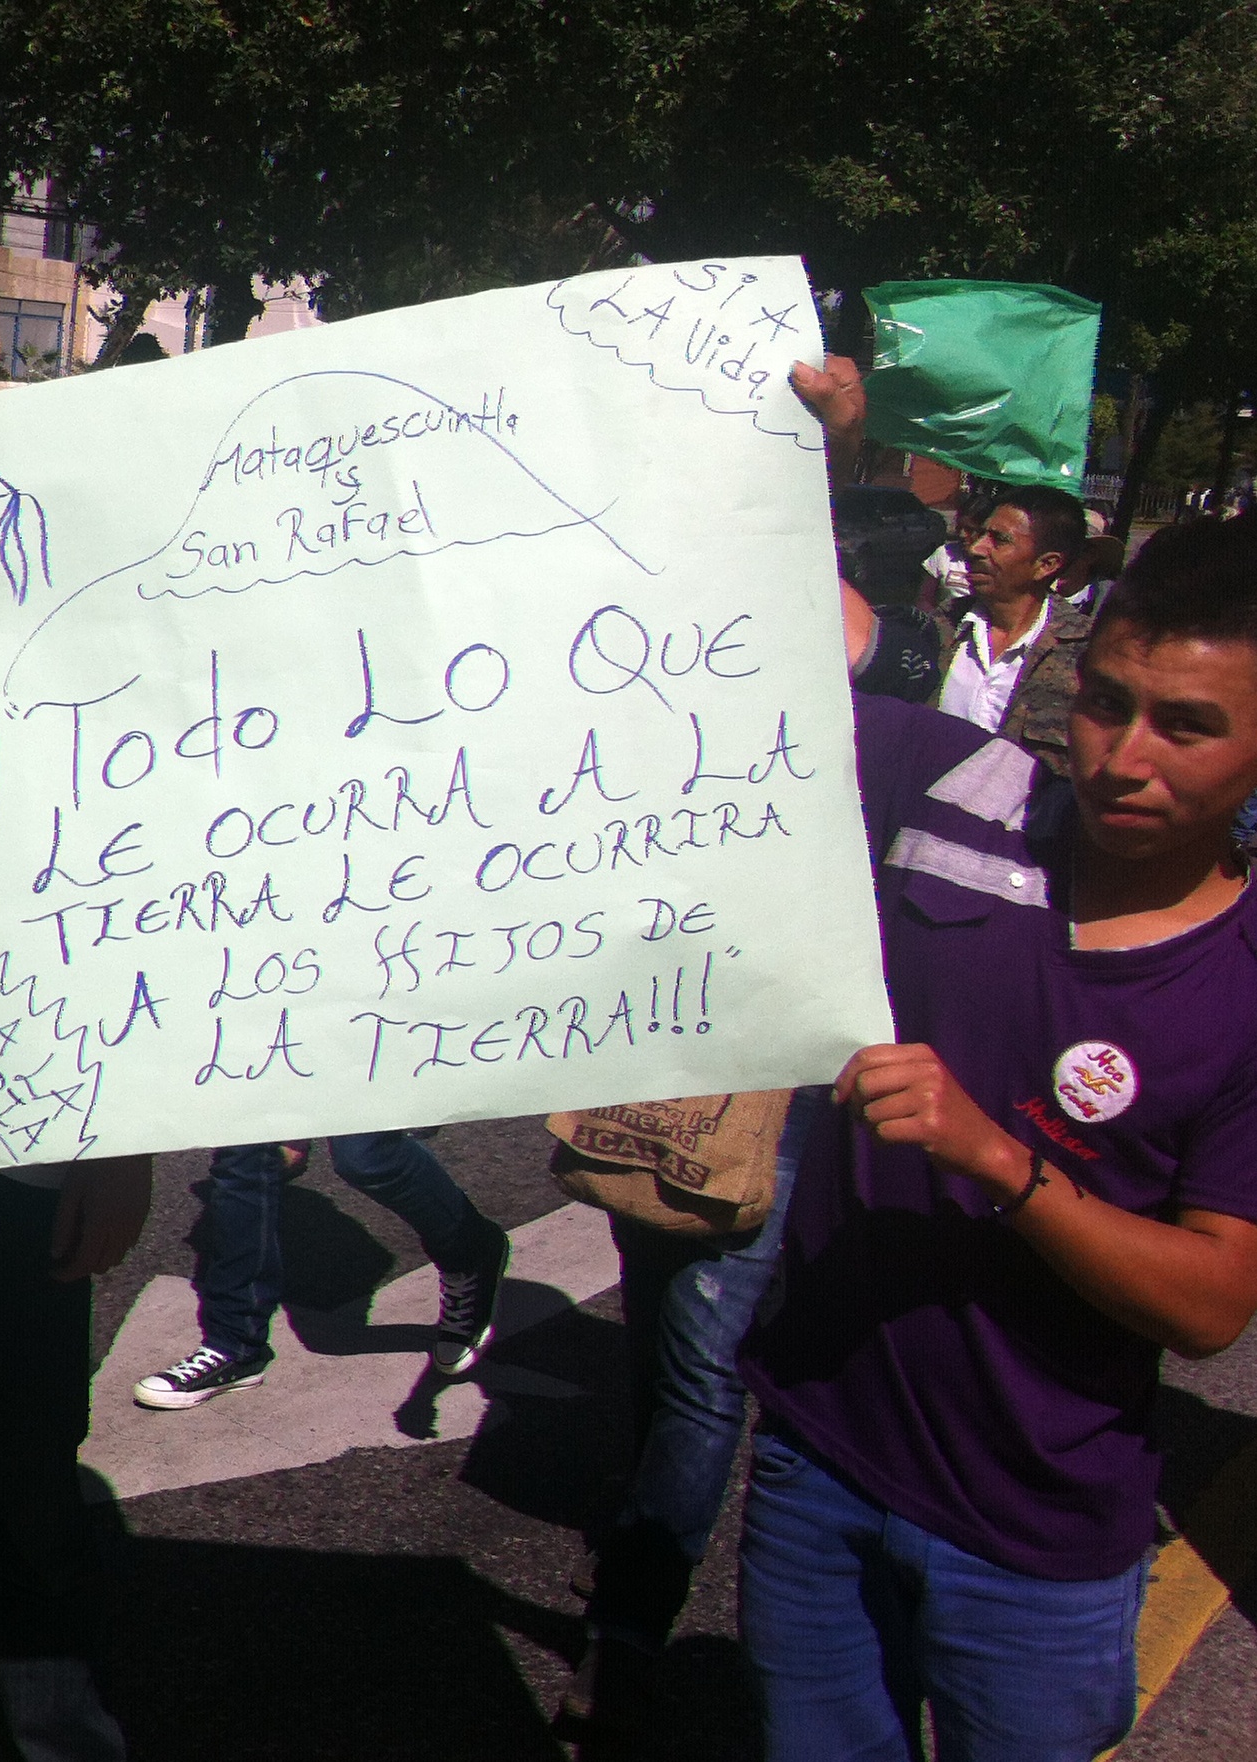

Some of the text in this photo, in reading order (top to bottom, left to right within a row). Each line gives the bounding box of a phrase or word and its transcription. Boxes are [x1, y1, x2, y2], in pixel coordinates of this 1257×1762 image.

[589, 274, 676, 341] LA
[165, 530, 258, 579] San
[344, 628, 510, 738] LO
[569, 604, 761, 714] QUE
[32, 710, 817, 894] LE OCURRA A LA
[21, 801, 793, 966] TIERRA LE OCURRIRA
[98, 898, 717, 1047] A LOS HIJOS DE
[13, 1052, 86, 1122] LA
[194, 1007, 314, 1086] LA
